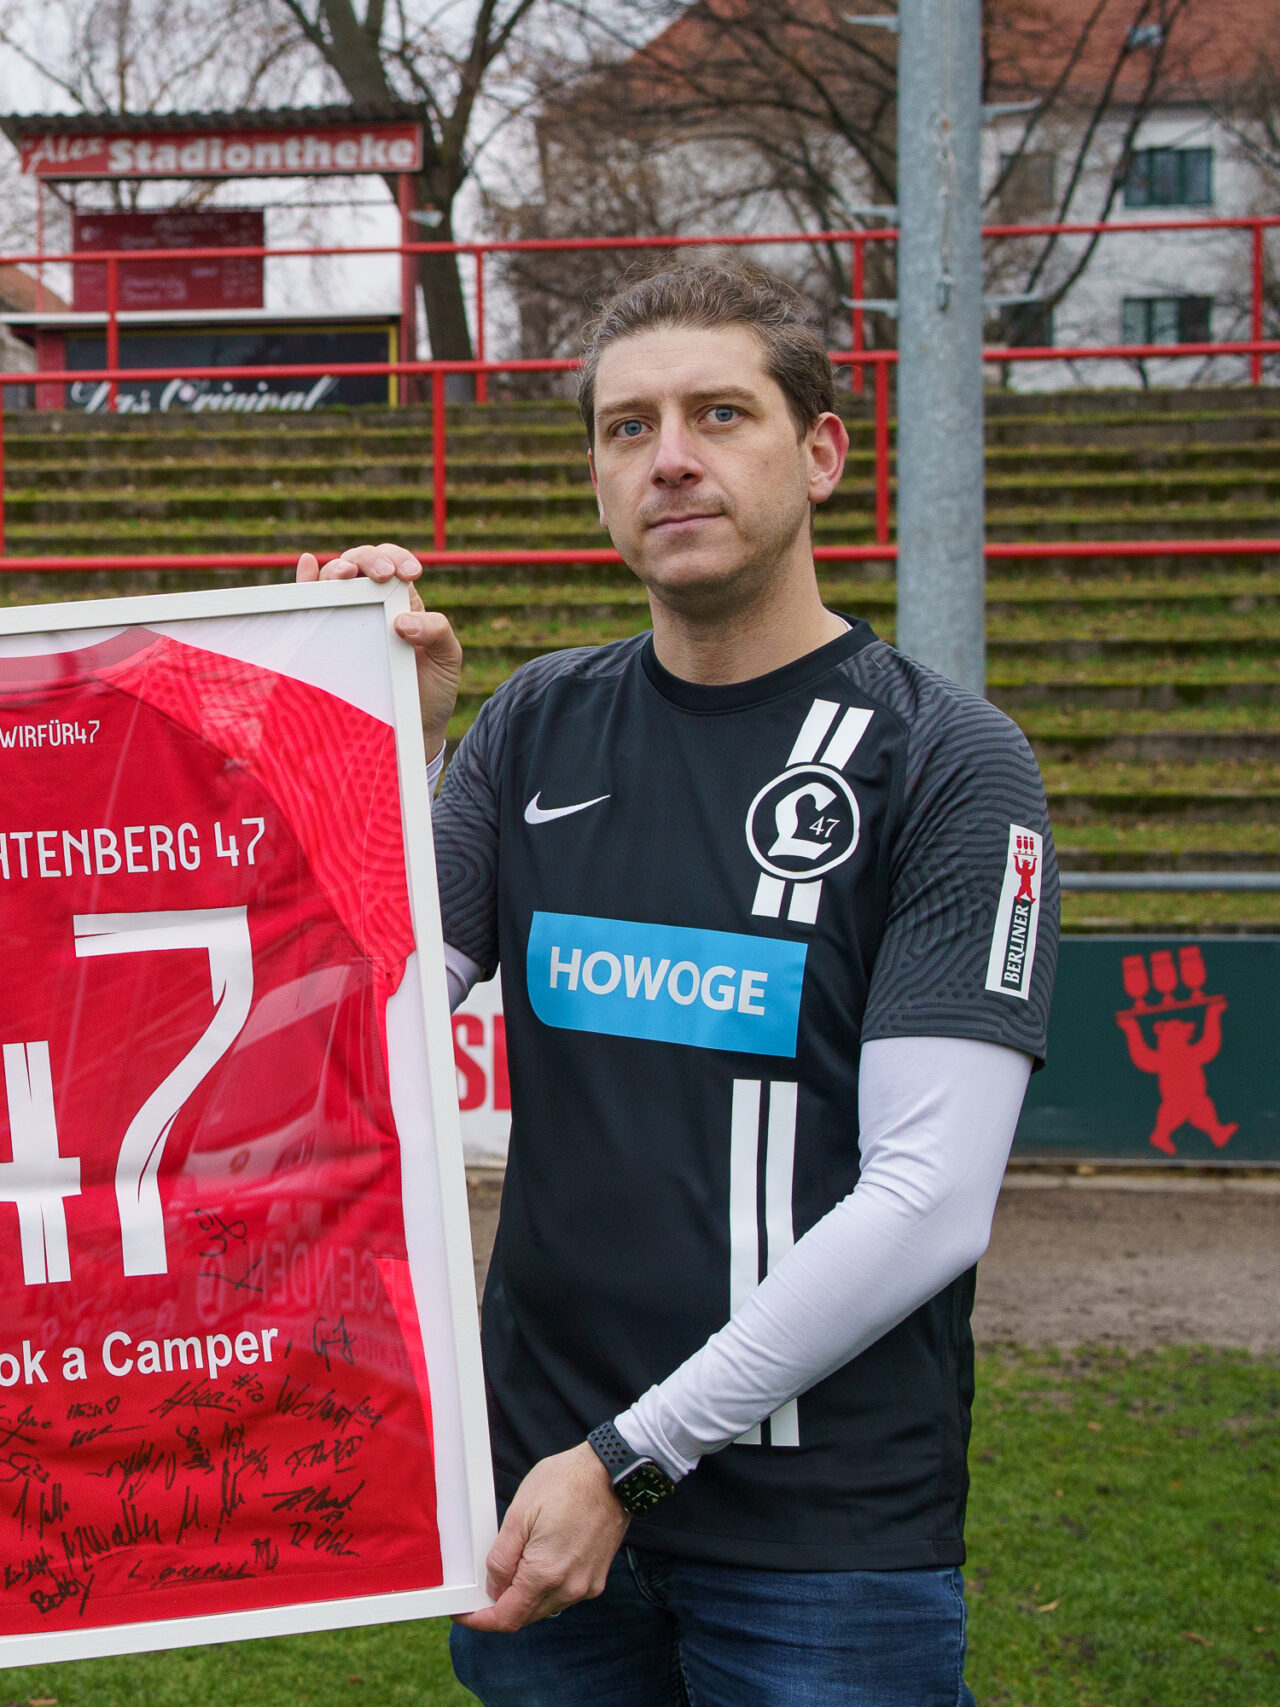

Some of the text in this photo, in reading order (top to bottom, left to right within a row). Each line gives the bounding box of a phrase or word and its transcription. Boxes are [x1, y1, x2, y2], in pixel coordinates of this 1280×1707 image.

[108, 134, 415, 172] Stadiontheke
[214, 816, 266, 867] 47
[809, 816, 840, 838] 47
[1003, 904, 1030, 985] BERLINER
[549, 945, 768, 1016] HOWOGE
[62, 1347, 88, 1381] a
[102, 1328, 279, 1380] Camper
